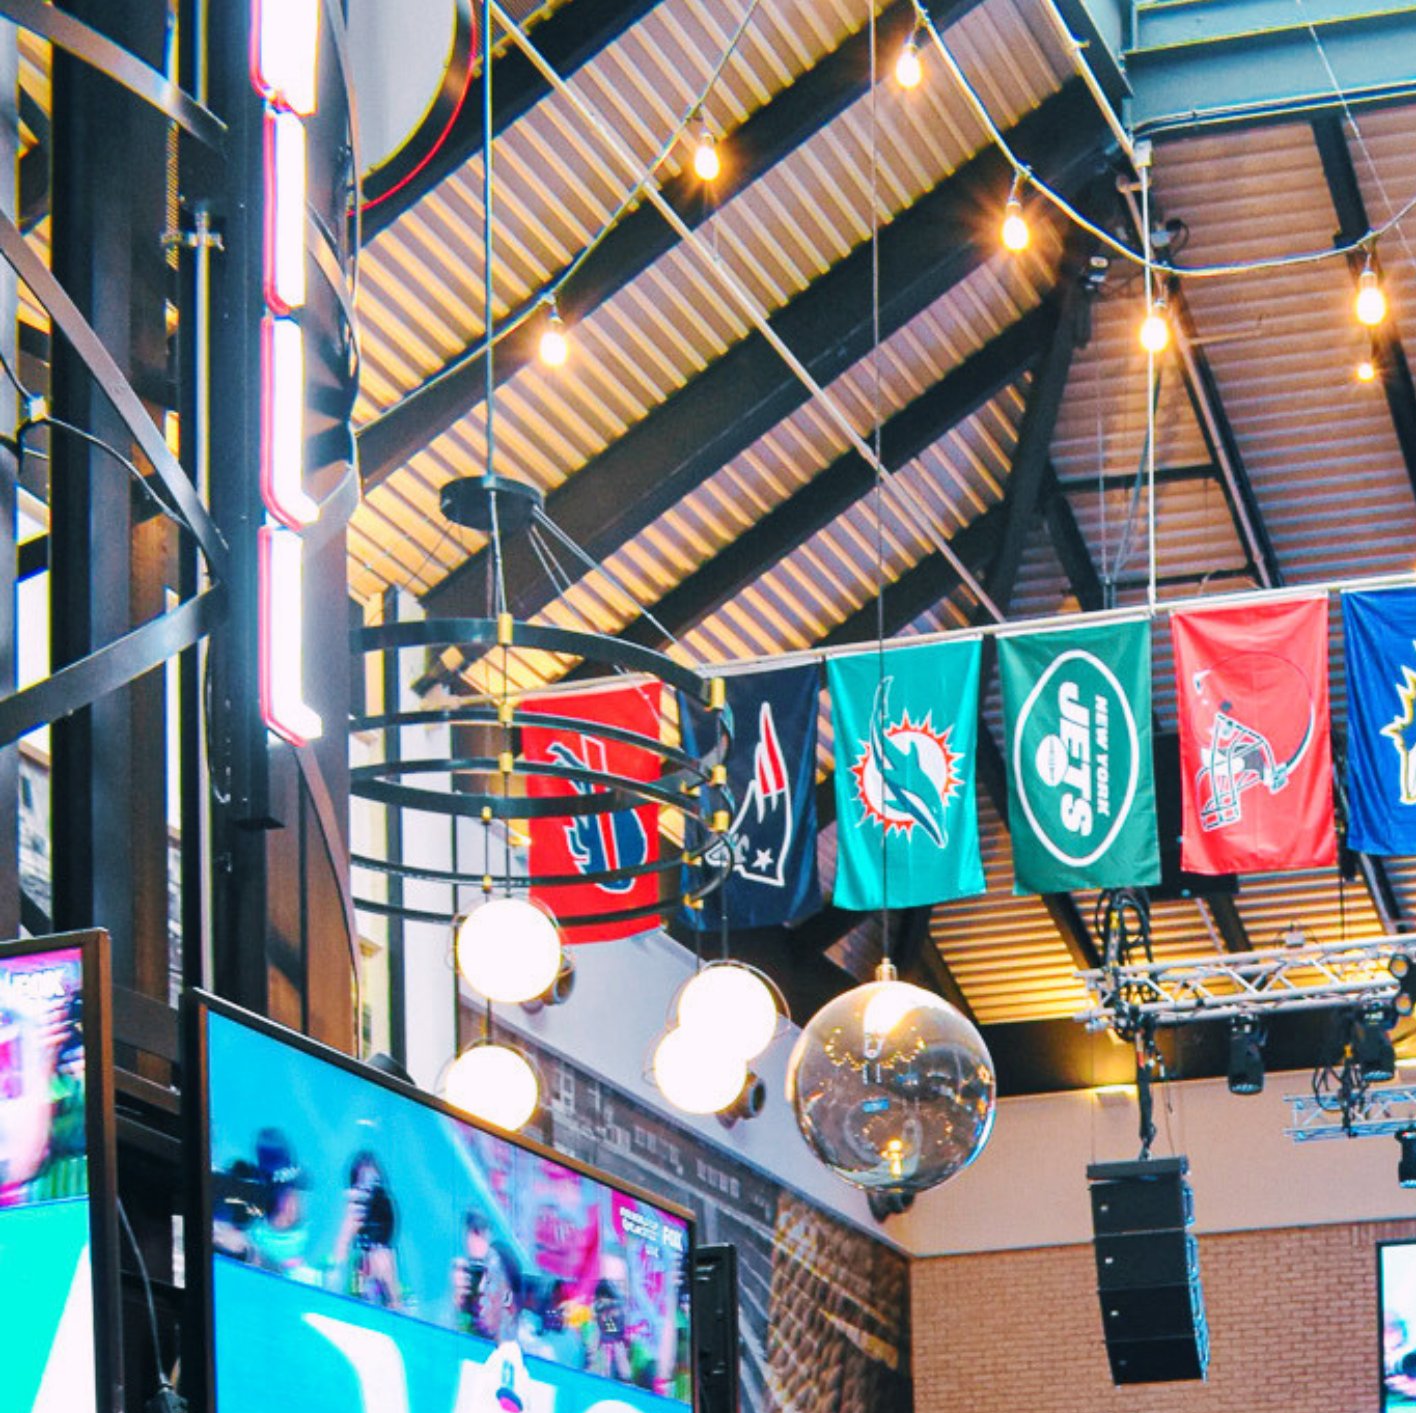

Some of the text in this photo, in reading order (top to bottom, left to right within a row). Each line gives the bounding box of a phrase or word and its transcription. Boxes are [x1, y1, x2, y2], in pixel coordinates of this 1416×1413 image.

[1059, 681, 1093, 836] JETS
[1095, 694, 1110, 817] NEW YORK
